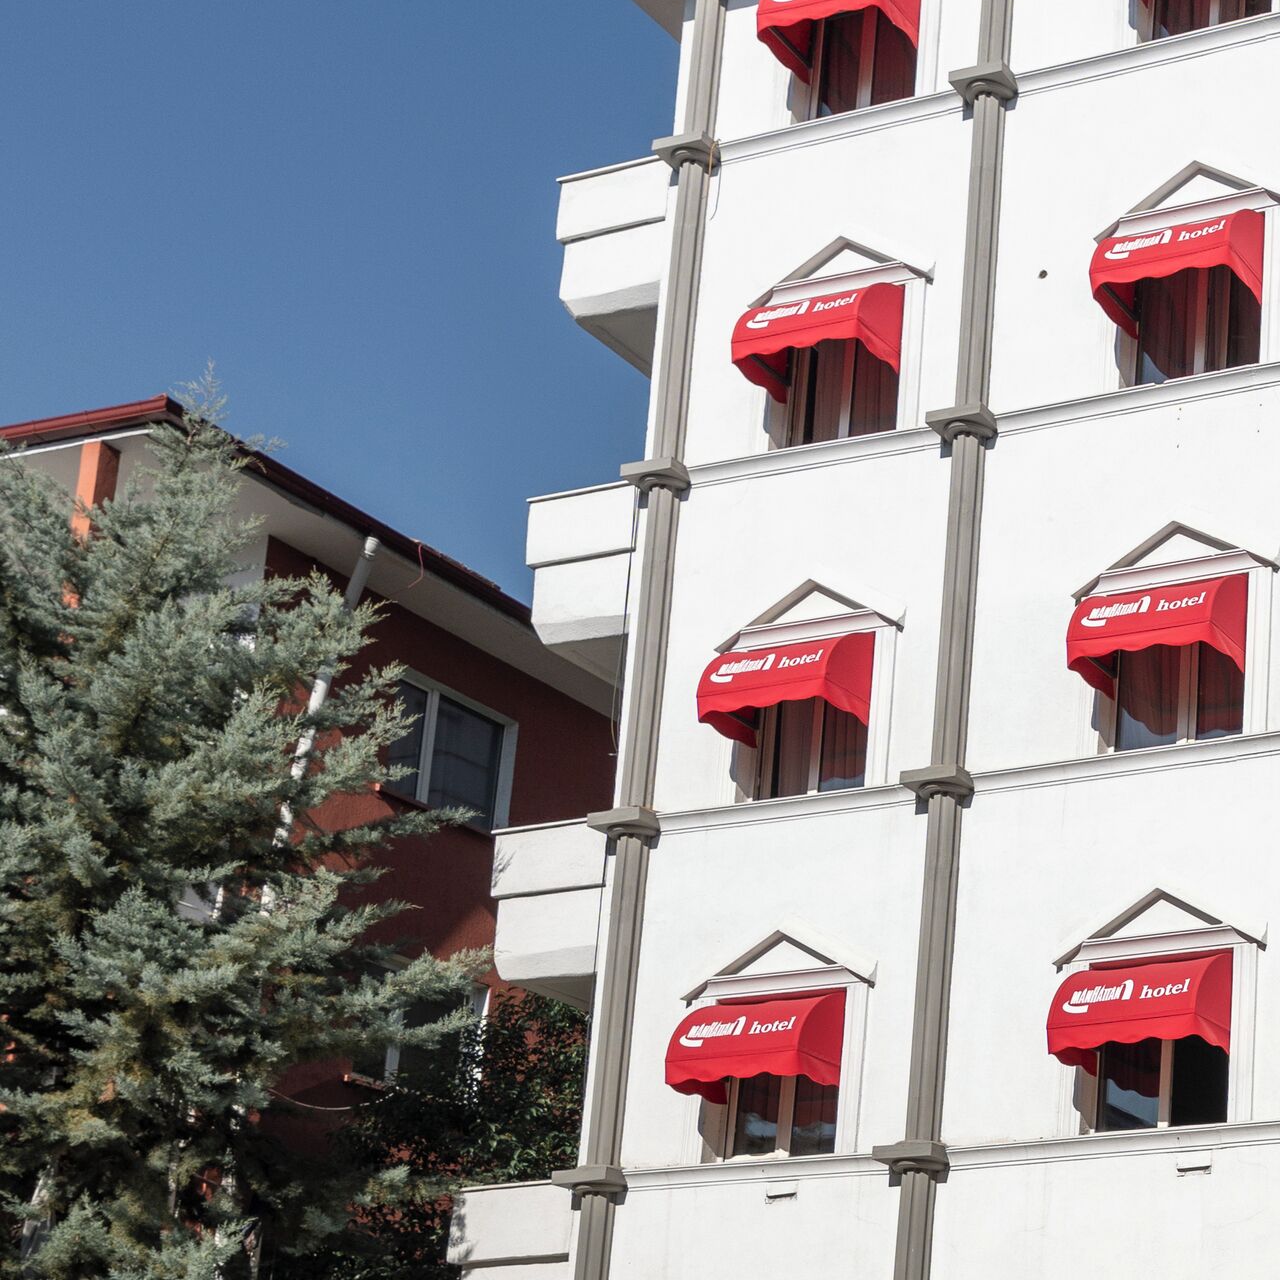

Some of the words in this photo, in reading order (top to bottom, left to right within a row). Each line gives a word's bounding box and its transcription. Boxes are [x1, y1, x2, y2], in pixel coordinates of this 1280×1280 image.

[1177, 219, 1226, 241] hotel
[812, 293, 858, 313] hotel
[1156, 592, 1206, 612] hotel
[777, 649, 823, 669] hotel
[1139, 978, 1190, 1000] hotel
[748, 1016, 796, 1035] hotel
